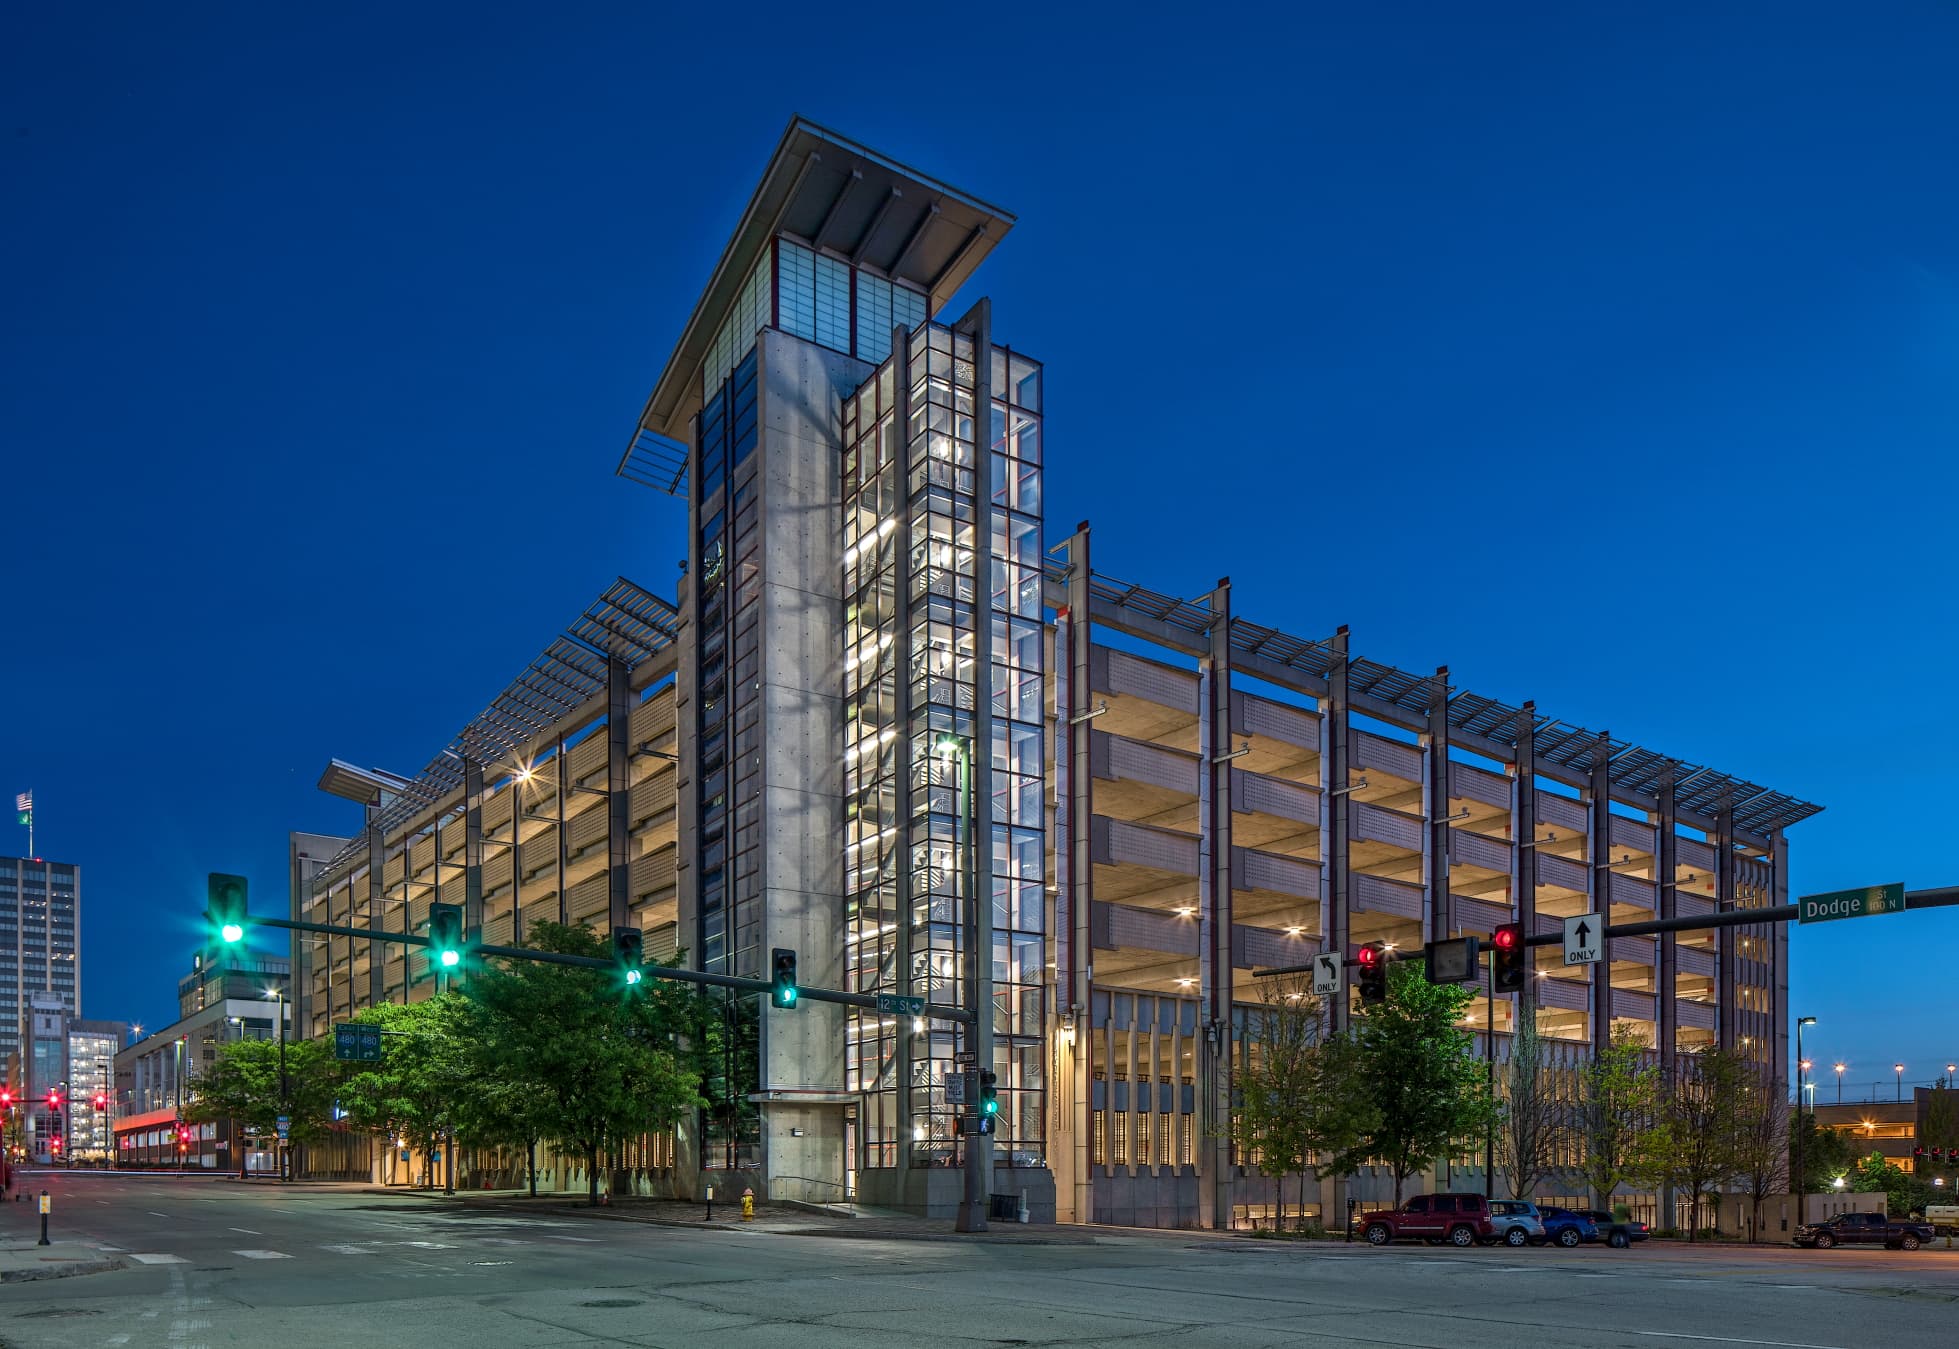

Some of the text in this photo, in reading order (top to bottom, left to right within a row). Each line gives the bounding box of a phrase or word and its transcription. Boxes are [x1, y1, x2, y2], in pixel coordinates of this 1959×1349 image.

[1877, 889, 1887, 900] St
[1807, 898, 1861, 918] Dodge
[1889, 898, 1896, 910] N
[1569, 949, 1596, 961] ONLY
[1317, 982, 1337, 993] ONLY
[899, 999, 909, 1011] St
[339, 1035, 355, 1044] 480
[361, 1036, 377, 1046] 480
